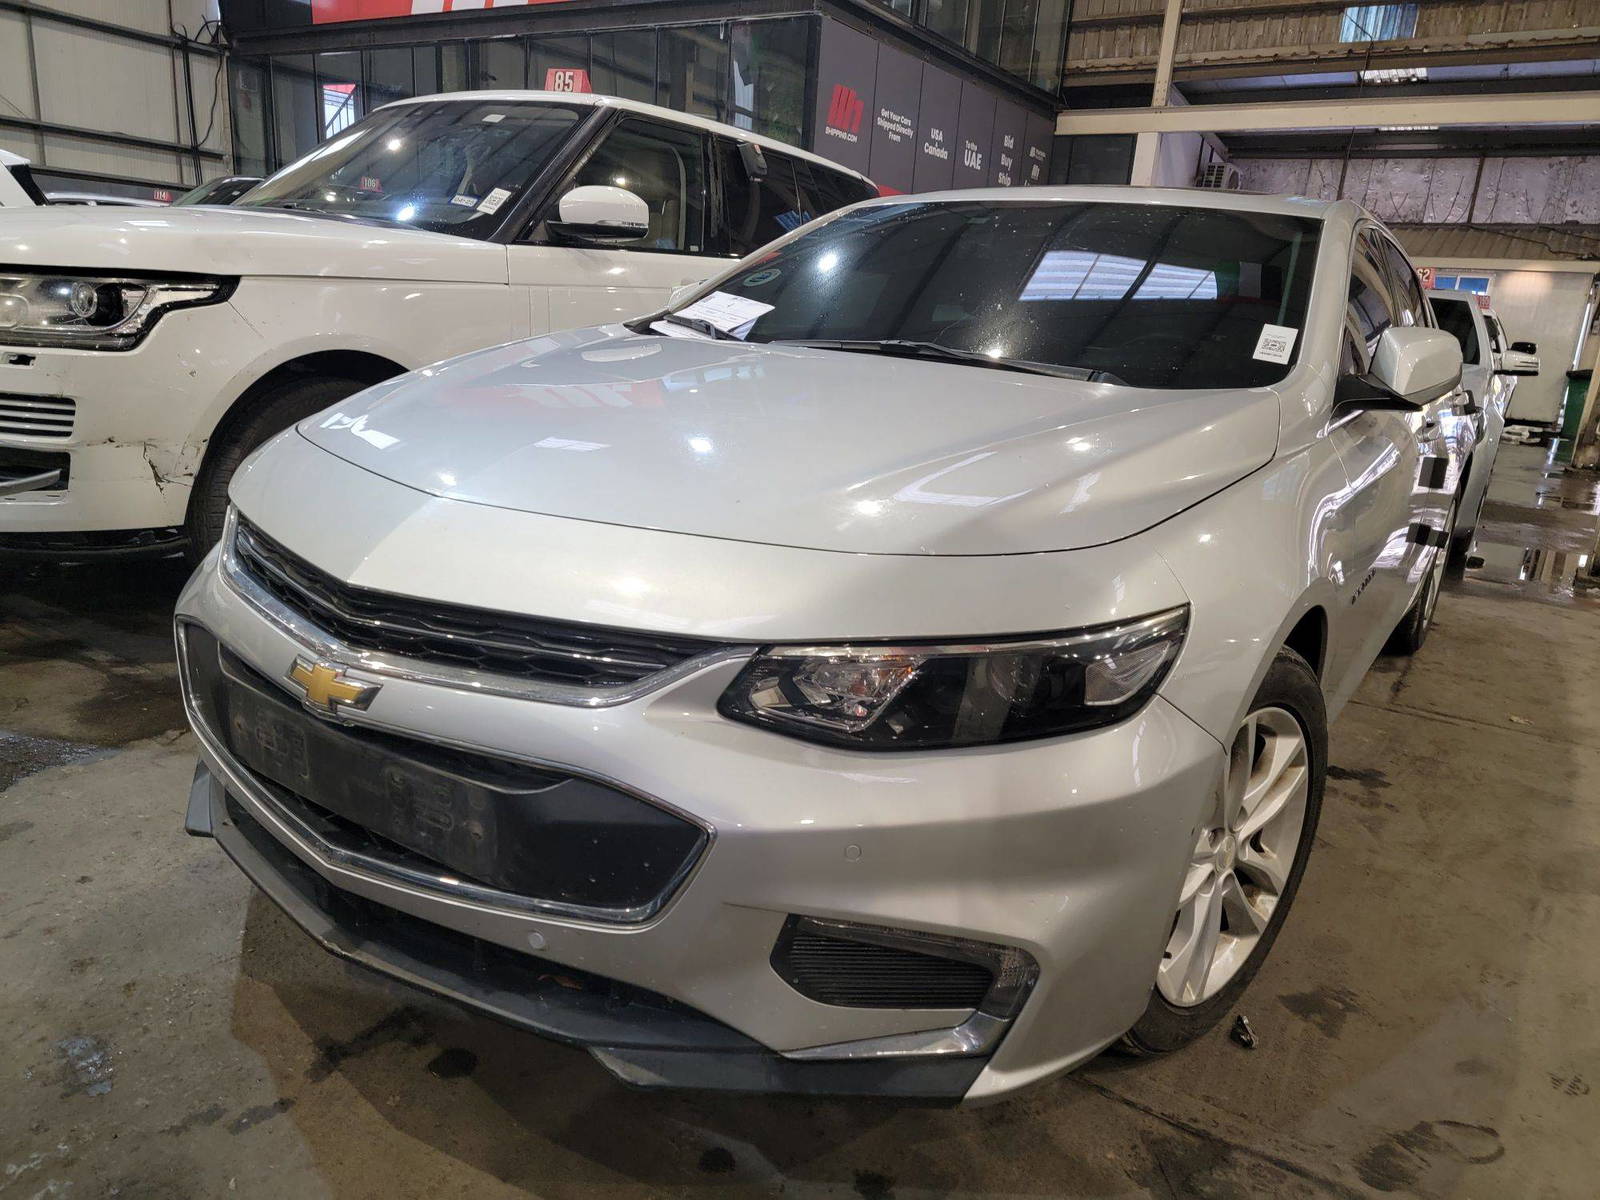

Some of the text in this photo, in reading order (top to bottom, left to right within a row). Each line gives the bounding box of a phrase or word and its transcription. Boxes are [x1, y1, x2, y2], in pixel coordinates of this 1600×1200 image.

[554, 71, 574, 92] 85
[901, 115, 911, 127] Cars
[825, 126, 858, 143] SHIPPING.COM
[930, 127, 943, 142] USA
[1003, 135, 1014, 149] Bid
[924, 142, 948, 160] Canada
[964, 149, 982, 170] UAE
[1000, 153, 1013, 171] Buy
[998, 172, 1011, 187] Ship
